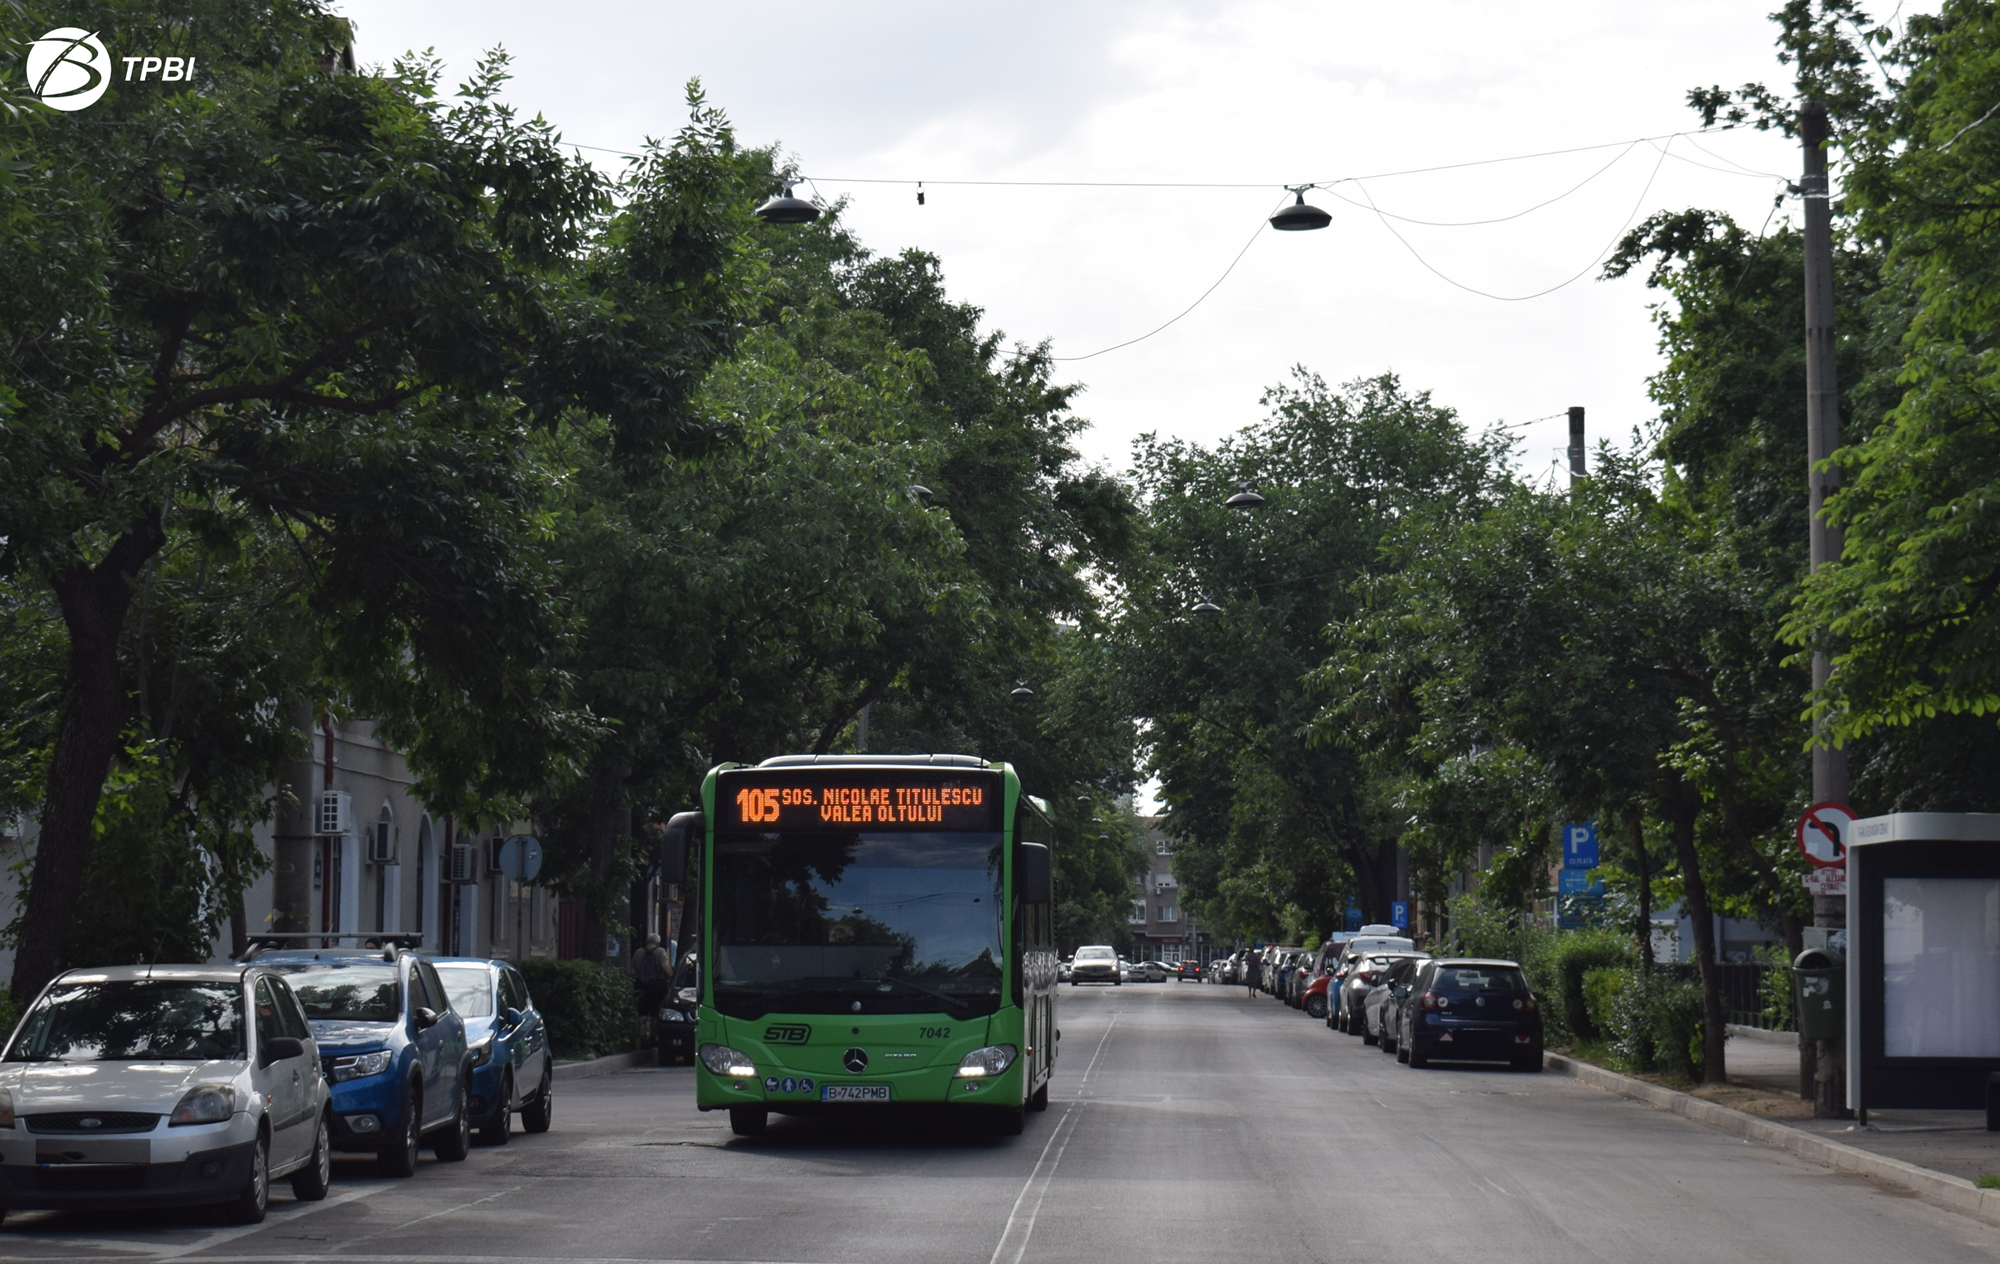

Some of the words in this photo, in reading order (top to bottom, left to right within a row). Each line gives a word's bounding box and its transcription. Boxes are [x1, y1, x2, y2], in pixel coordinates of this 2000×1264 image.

[737, 788, 780, 822] 105
[782, 788, 818, 805] SOS.
[823, 788, 890, 805] NICOLAE
[896, 788, 983, 805] TITULESCU
[820, 805, 872, 822] VALEA
[878, 805, 942, 822] OLTULUI
[1571, 828, 1589, 854] P
[1395, 905, 1404, 921] P
[763, 1025, 808, 1042] STB
[919, 1027, 951, 1038] 7042
